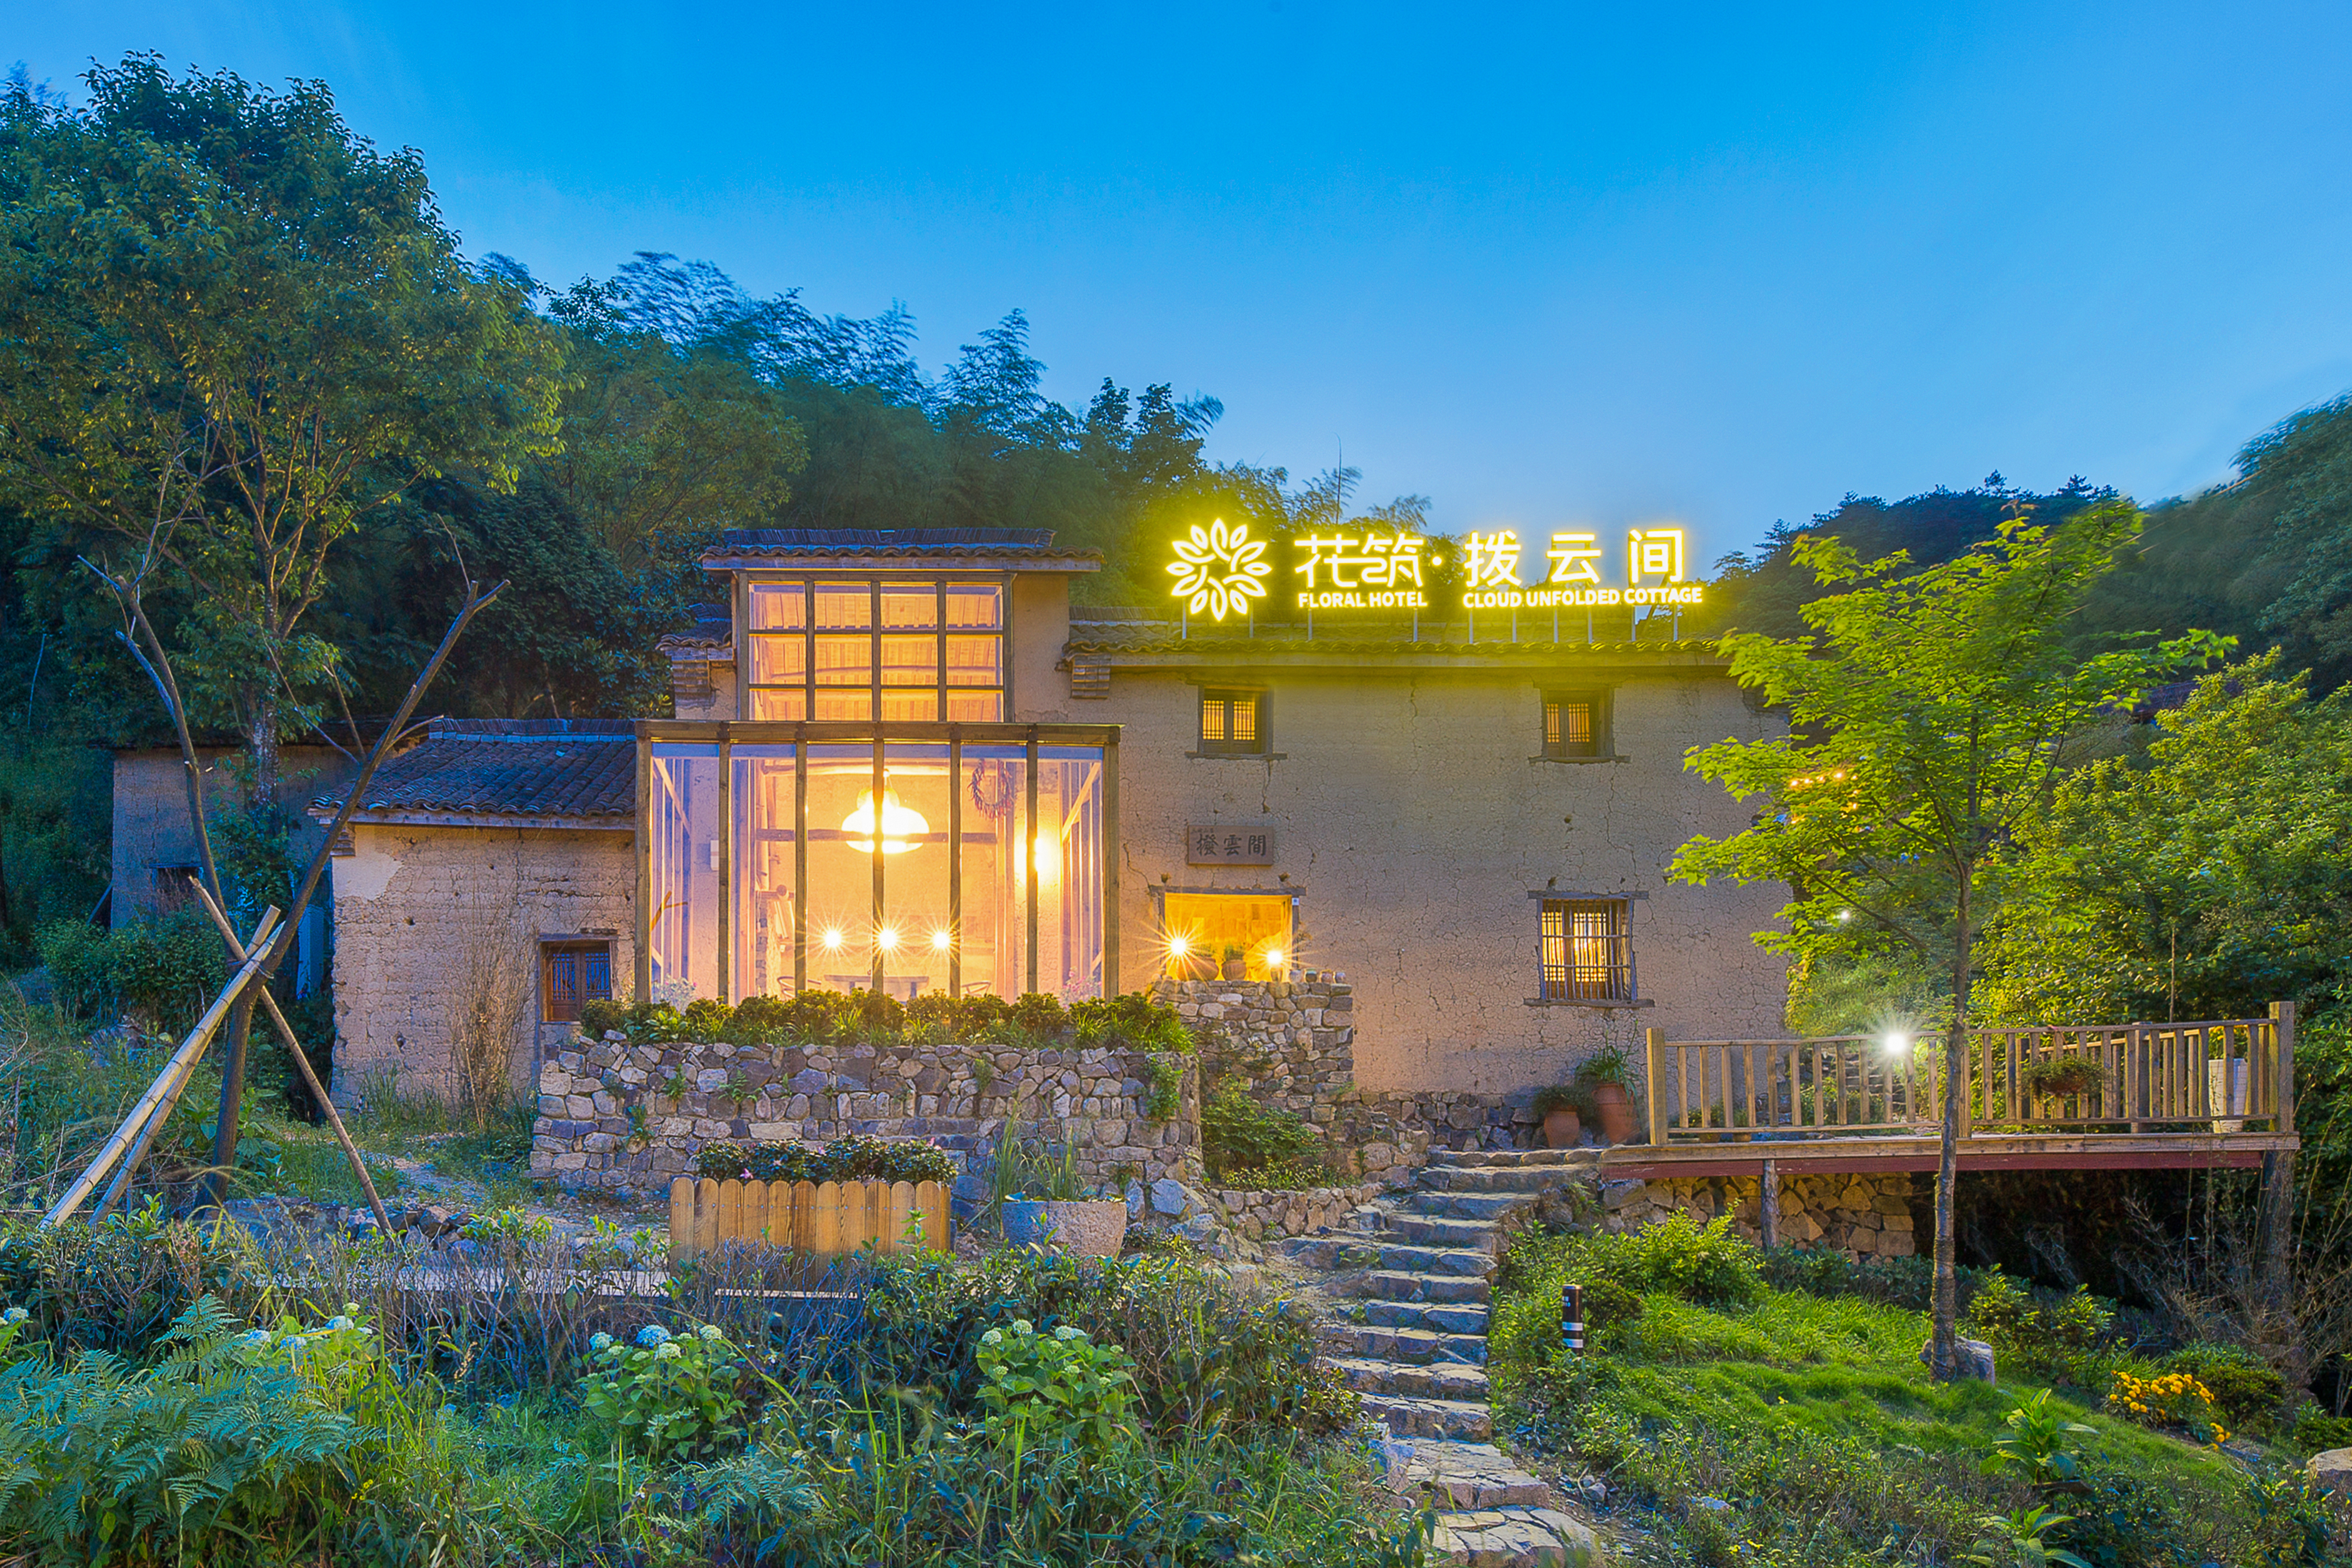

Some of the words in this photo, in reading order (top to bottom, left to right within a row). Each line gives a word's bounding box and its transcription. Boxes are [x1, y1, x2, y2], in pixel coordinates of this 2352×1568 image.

[1298, 593, 1366, 608] FLORAL
[1369, 591, 1428, 607] HOTEL
[1462, 592, 1522, 608] CLOUD
[1526, 590, 1620, 607] UNFOLDED
[1623, 587, 1703, 604] COTTAGE
